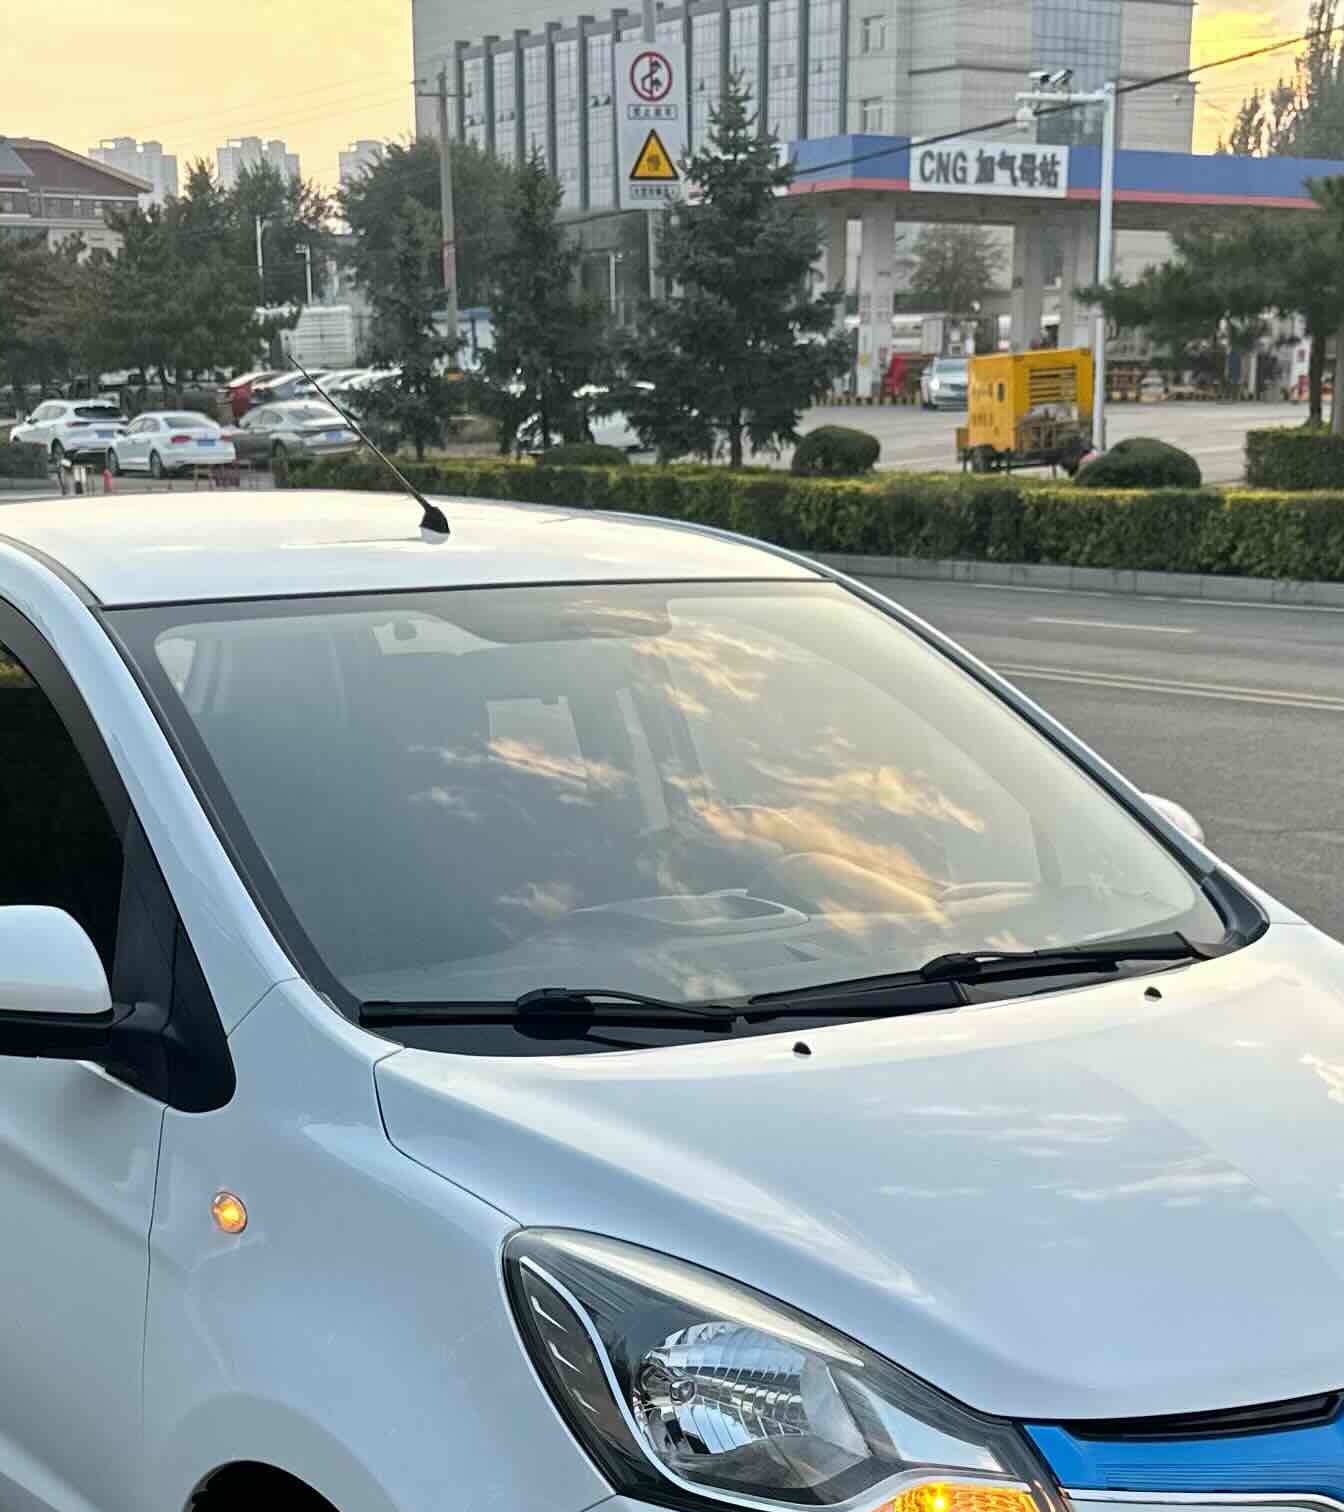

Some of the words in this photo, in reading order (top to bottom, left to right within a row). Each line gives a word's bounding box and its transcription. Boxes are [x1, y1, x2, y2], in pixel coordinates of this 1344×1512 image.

[920, 150, 968, 183] CNG
[975, 149, 1061, 188] 加气母站
